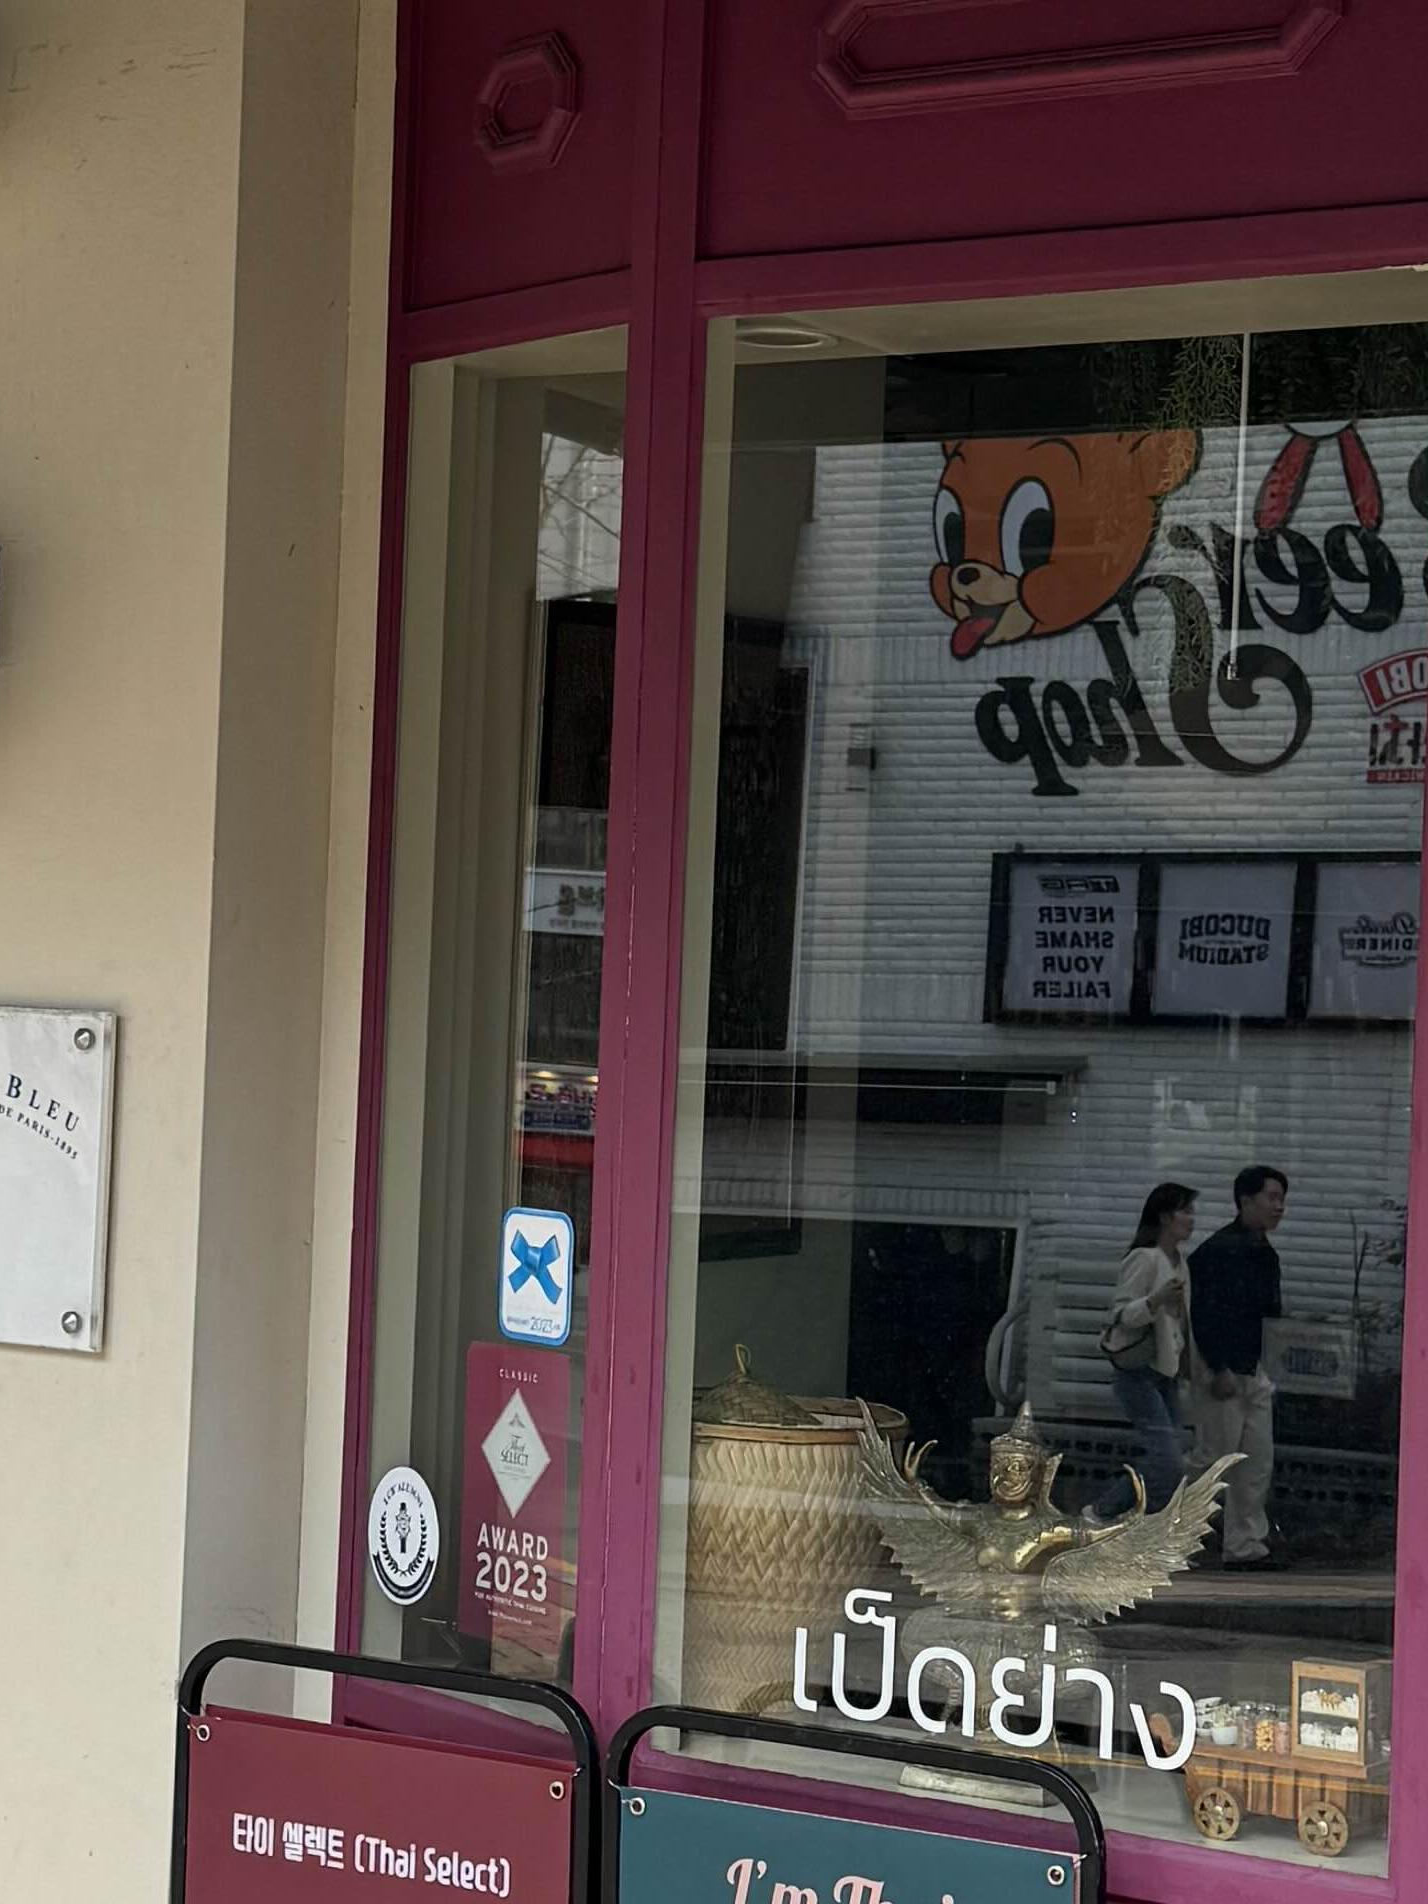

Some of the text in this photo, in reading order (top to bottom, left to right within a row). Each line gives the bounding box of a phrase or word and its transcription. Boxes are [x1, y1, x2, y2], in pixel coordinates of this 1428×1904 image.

[7, 1074, 81, 1133] BLEU
[499, 1368, 539, 1384] CLASSIC
[476, 1522, 549, 1561] AWARD
[476, 1551, 548, 1603] 2023
[794, 1588, 1197, 1771] เป็ดย่าง
[233, 1812, 511, 1899] 타이 셀렉트 (Thai Select)
